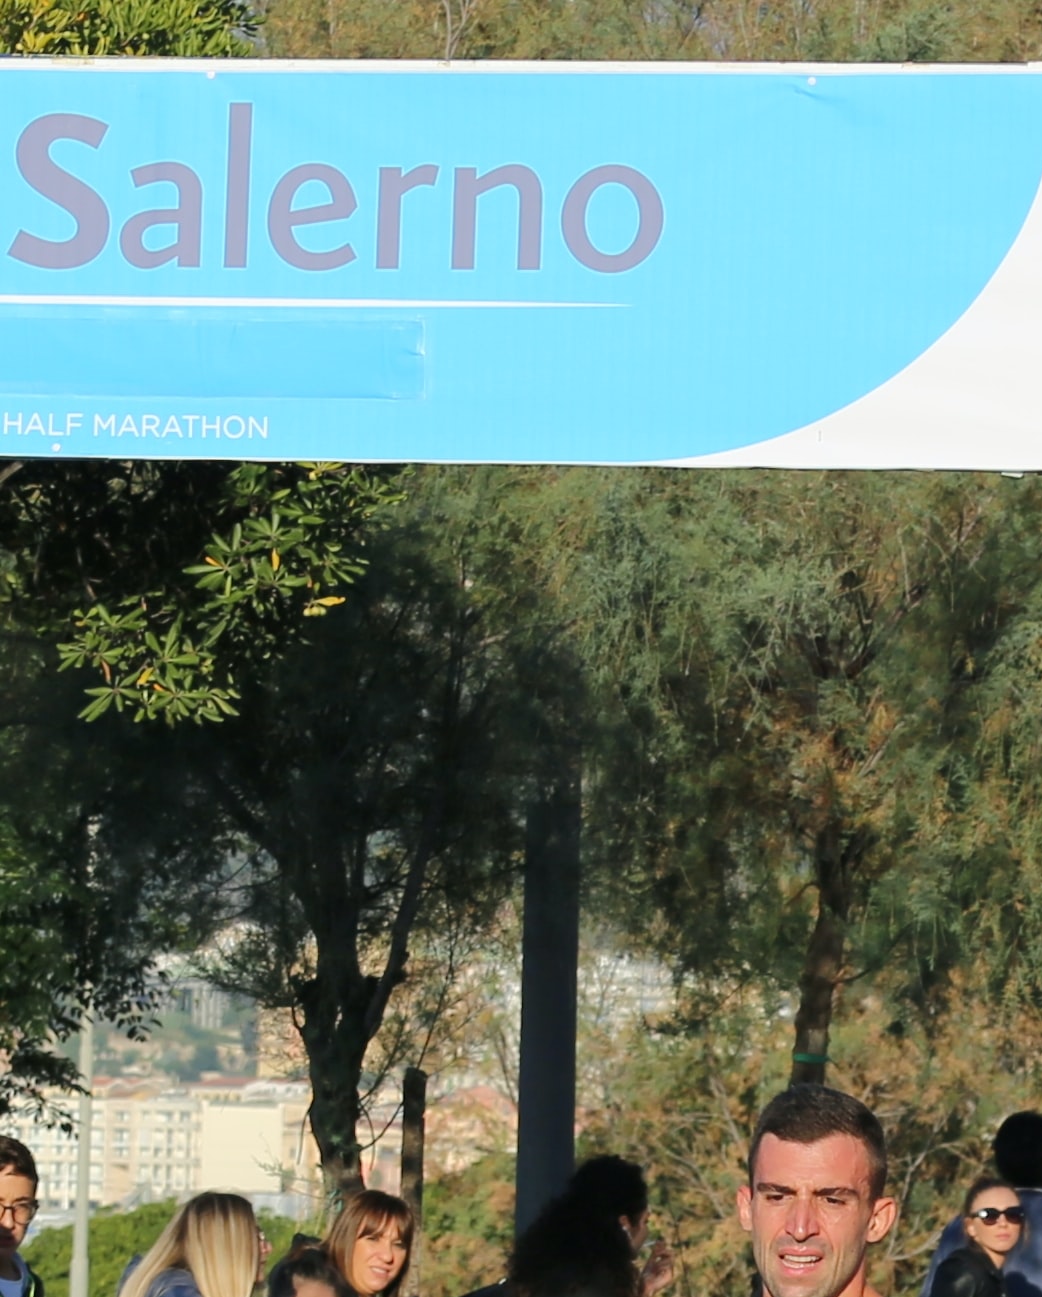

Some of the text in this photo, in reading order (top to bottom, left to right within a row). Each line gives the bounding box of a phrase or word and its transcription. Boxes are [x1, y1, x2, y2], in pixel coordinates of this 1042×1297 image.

[6, 101, 665, 273] Salerno
[3, 412, 269, 439] HALF MARATHON
